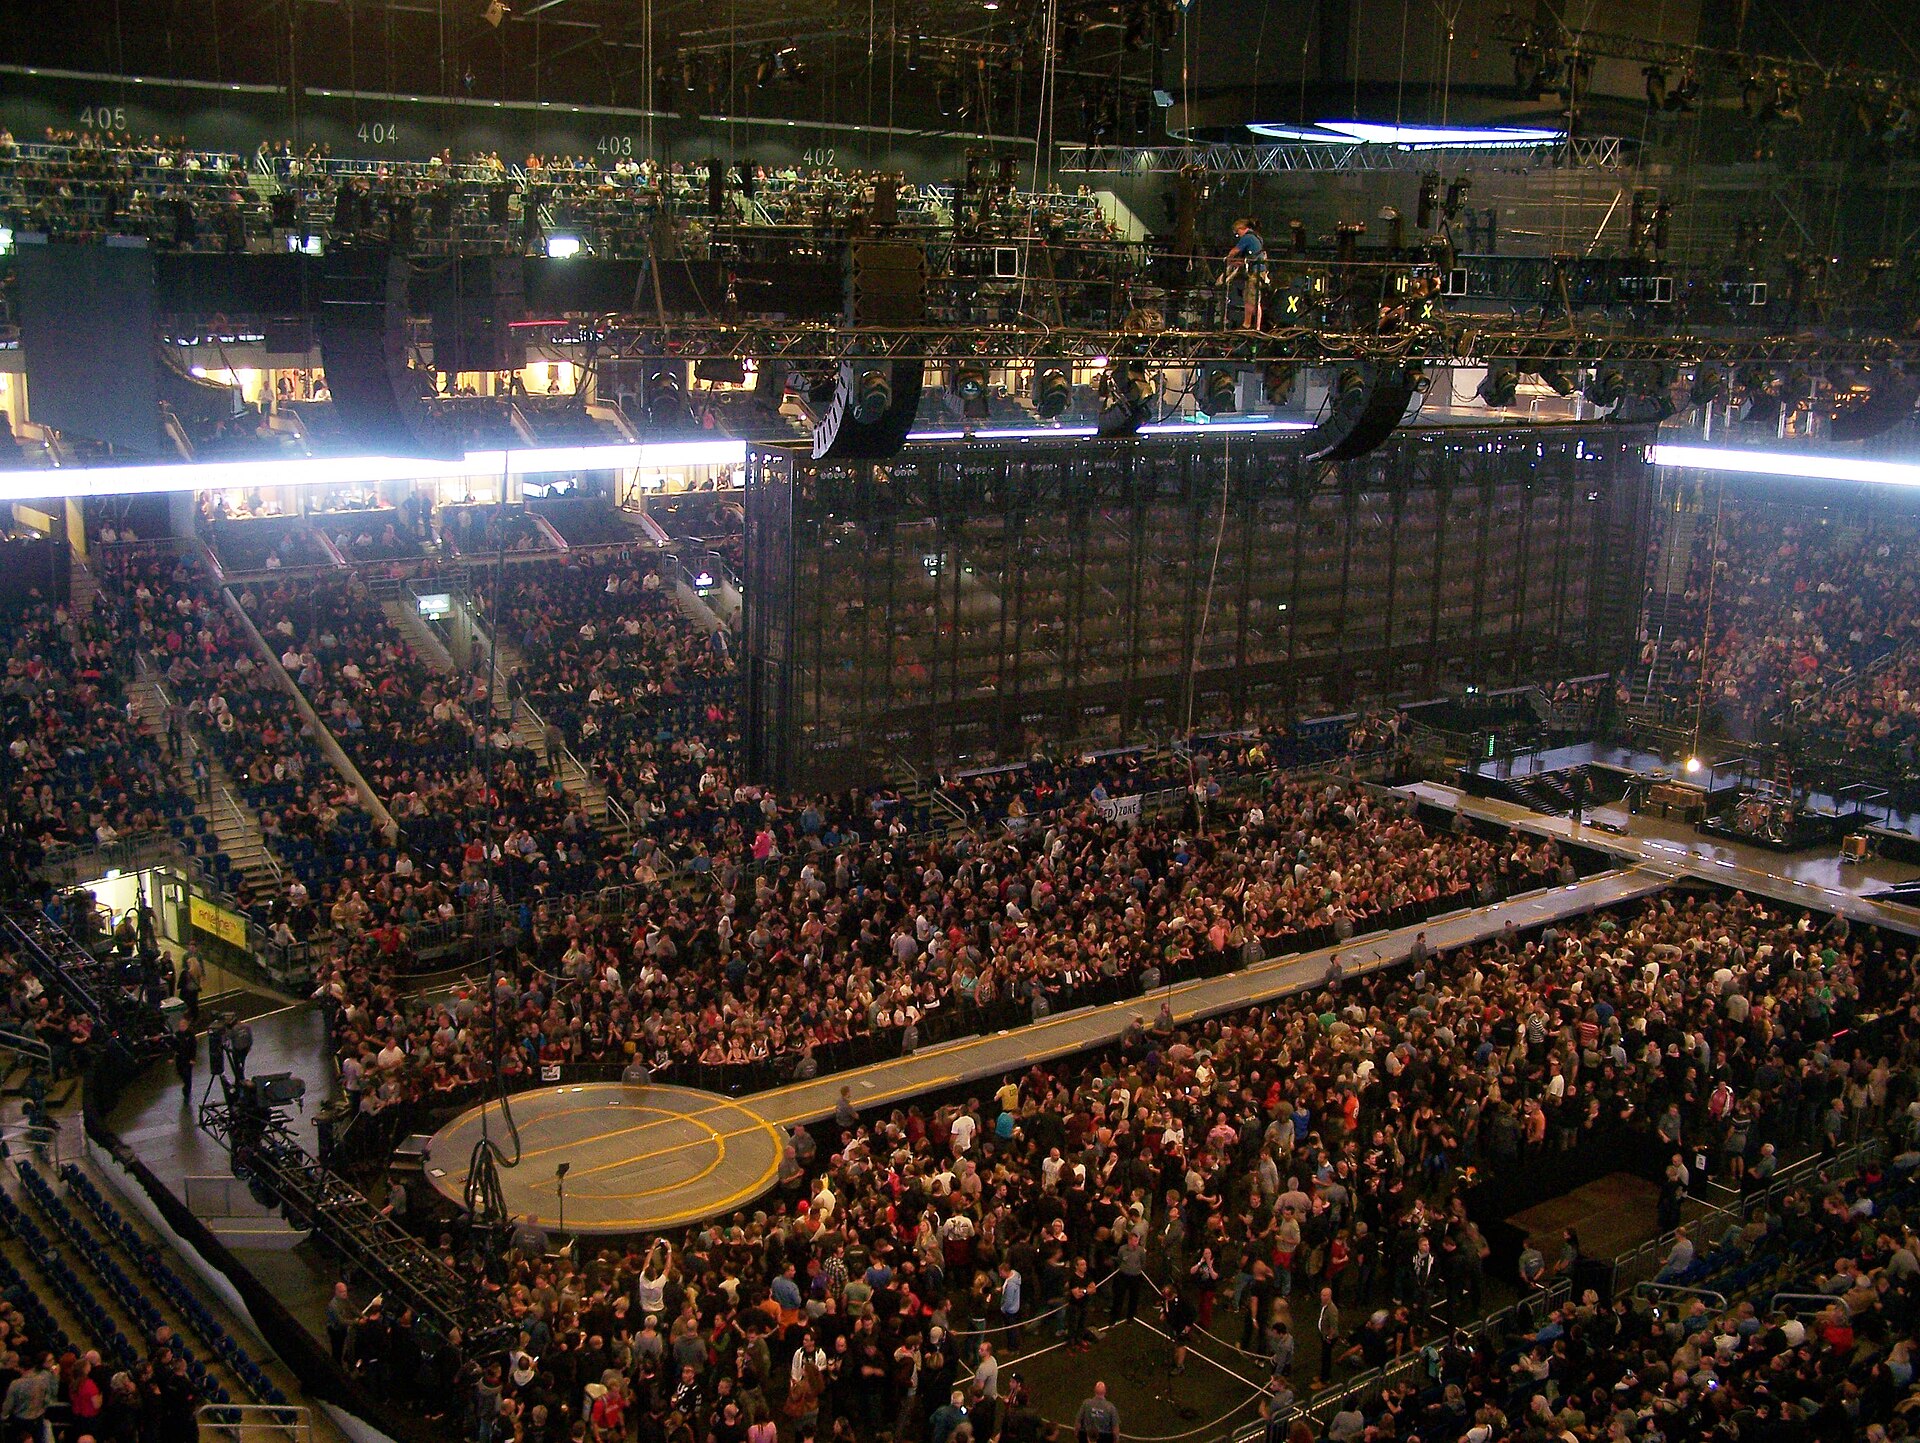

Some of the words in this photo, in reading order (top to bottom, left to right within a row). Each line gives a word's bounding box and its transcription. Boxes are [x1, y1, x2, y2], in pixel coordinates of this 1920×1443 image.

[80, 106, 126, 130] 405
[357, 122, 399, 145] 404
[596, 136, 632, 156] 403
[802, 148, 835, 167] 402
[1119, 803, 1137, 816] ZONE
